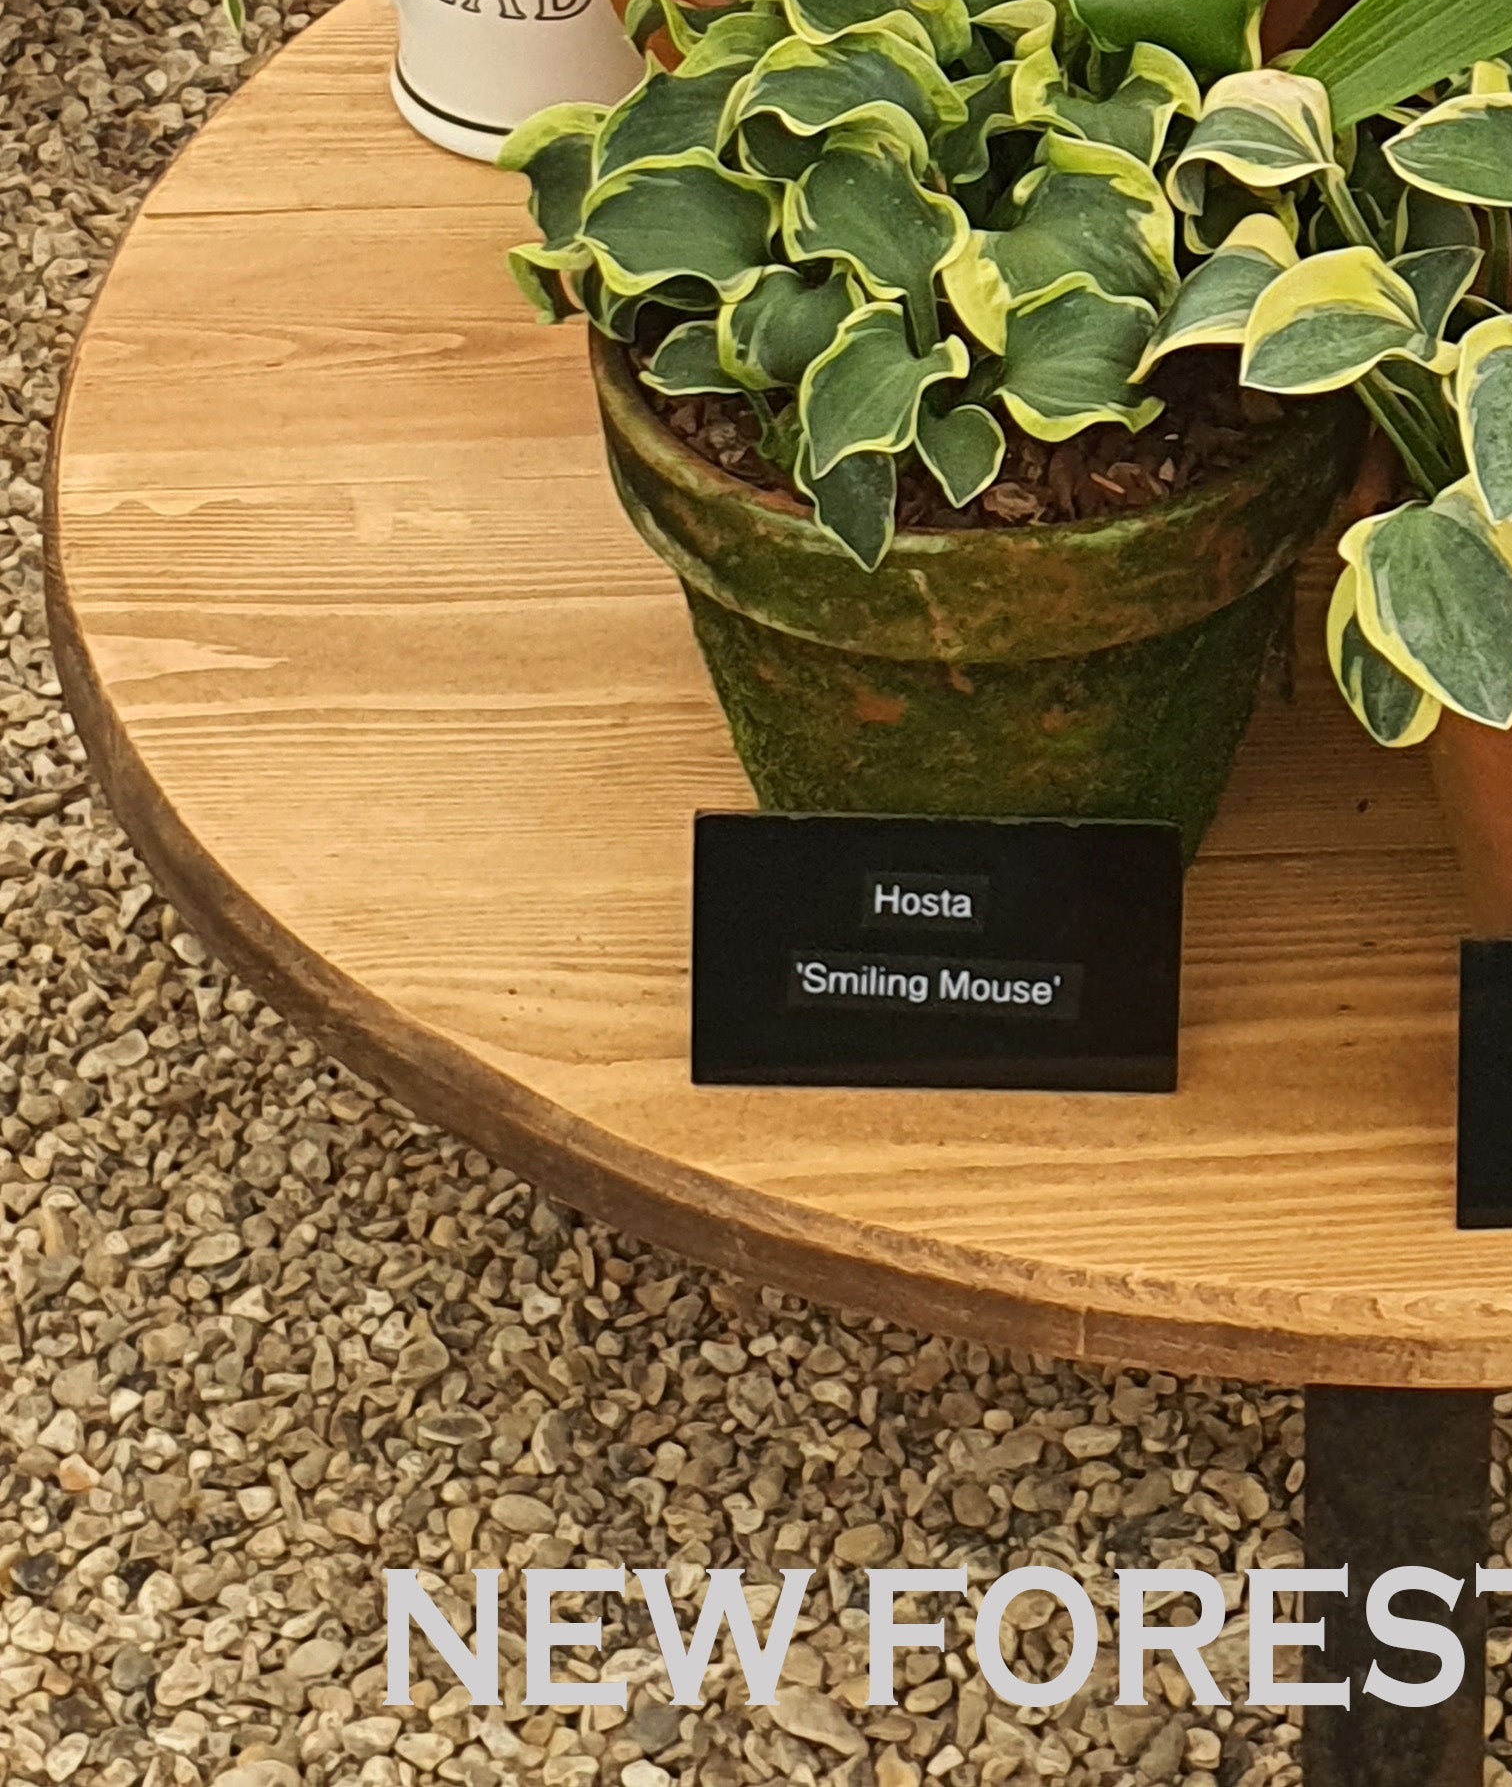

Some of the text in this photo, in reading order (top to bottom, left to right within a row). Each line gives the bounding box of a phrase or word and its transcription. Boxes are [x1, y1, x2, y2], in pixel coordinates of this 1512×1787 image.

[874, 883, 972, 919] Hosta
[796, 962, 1061, 1005] 'Smiling Mouse'
